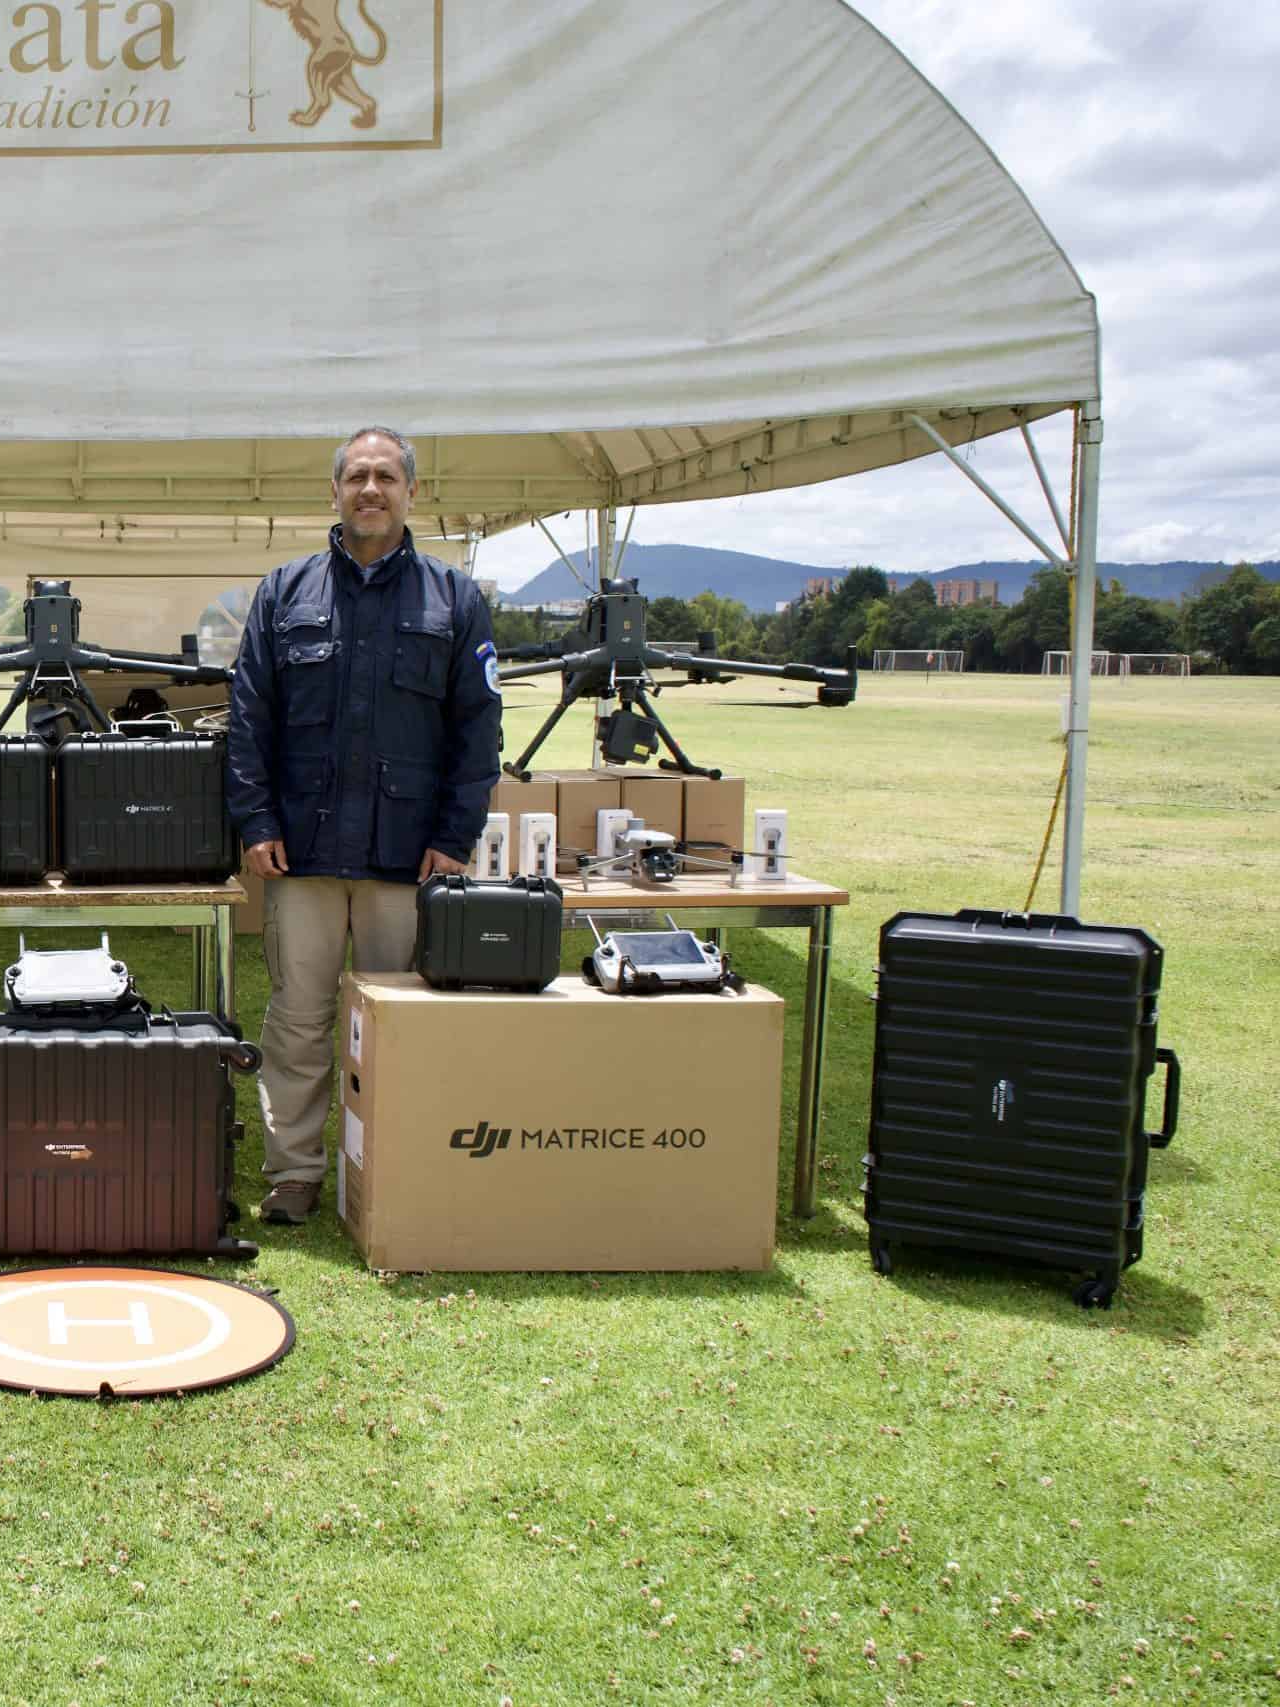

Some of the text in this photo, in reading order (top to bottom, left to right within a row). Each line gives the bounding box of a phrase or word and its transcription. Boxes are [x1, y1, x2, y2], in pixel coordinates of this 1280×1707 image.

[521, 1128, 645, 1149] MATRICE
[652, 1128, 706, 1149] 400
[47, 1301, 154, 1345] H
